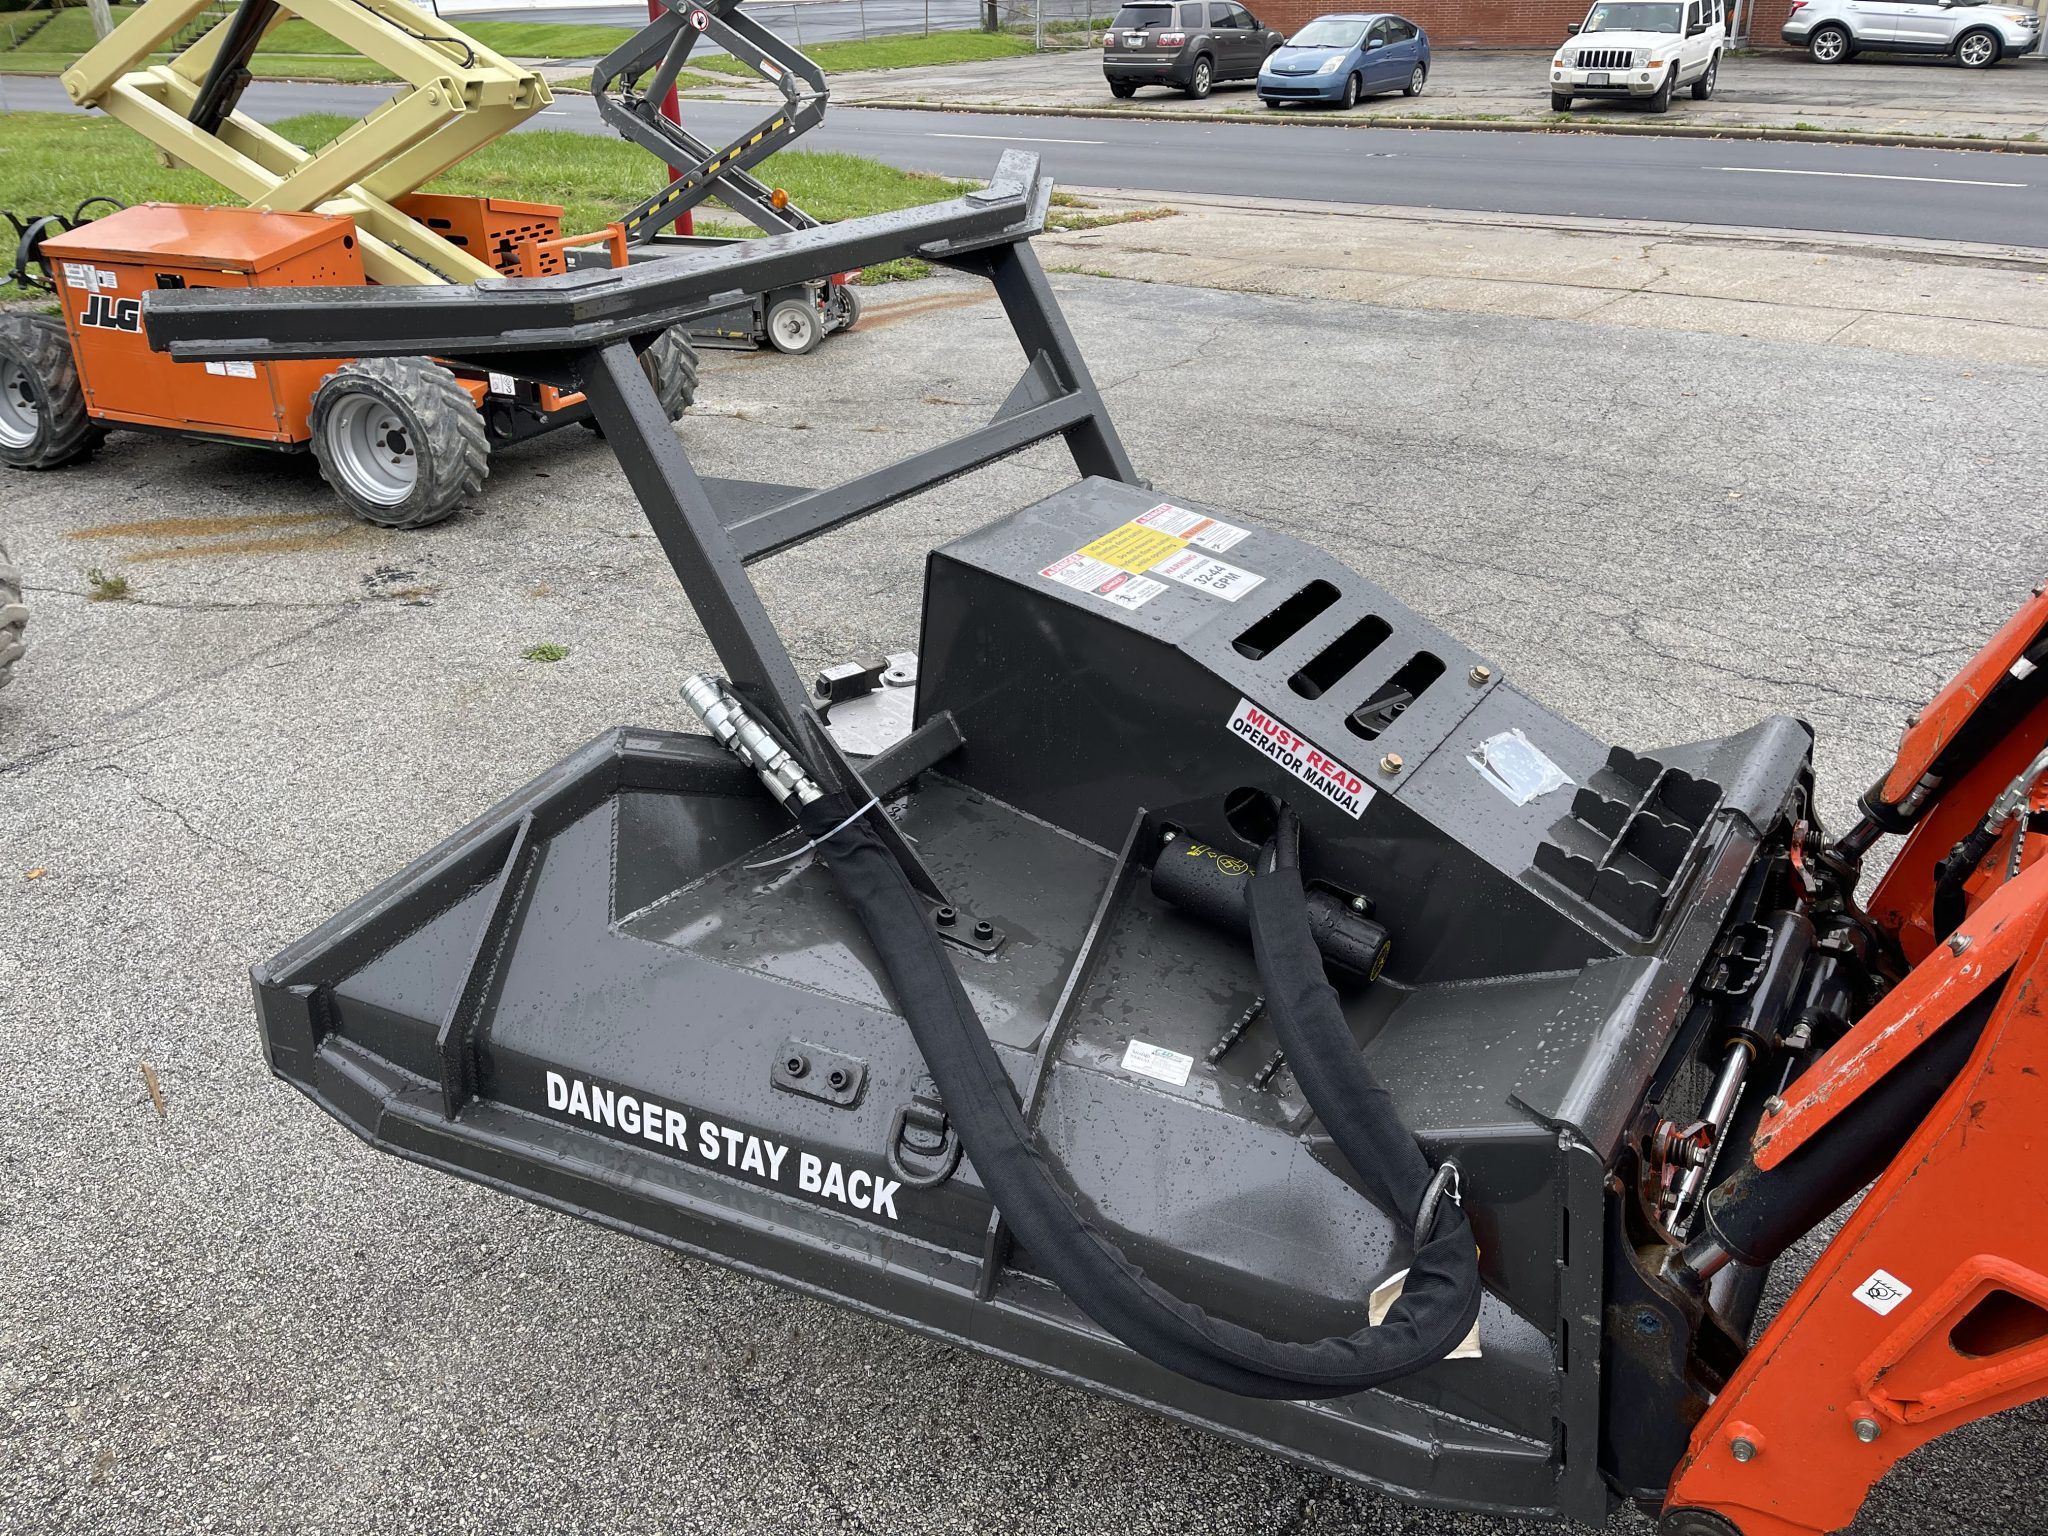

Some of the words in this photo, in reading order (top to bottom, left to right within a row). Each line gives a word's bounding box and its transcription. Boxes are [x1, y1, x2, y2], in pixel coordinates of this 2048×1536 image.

[80, 293, 142, 333] JLG
[1164, 553, 1198, 575] WARNING
[1193, 565, 1227, 585] 32-44
[1212, 572, 1241, 589] GPM
[1233, 718, 1303, 774] OPERATOR
[1302, 767, 1360, 815] MANUAL
[1246, 708, 1305, 753] MUST
[1306, 750, 1362, 795] READ
[546, 1070, 688, 1151] DANGER
[698, 1121, 789, 1181] STAY
[799, 1151, 901, 1220] BACK
